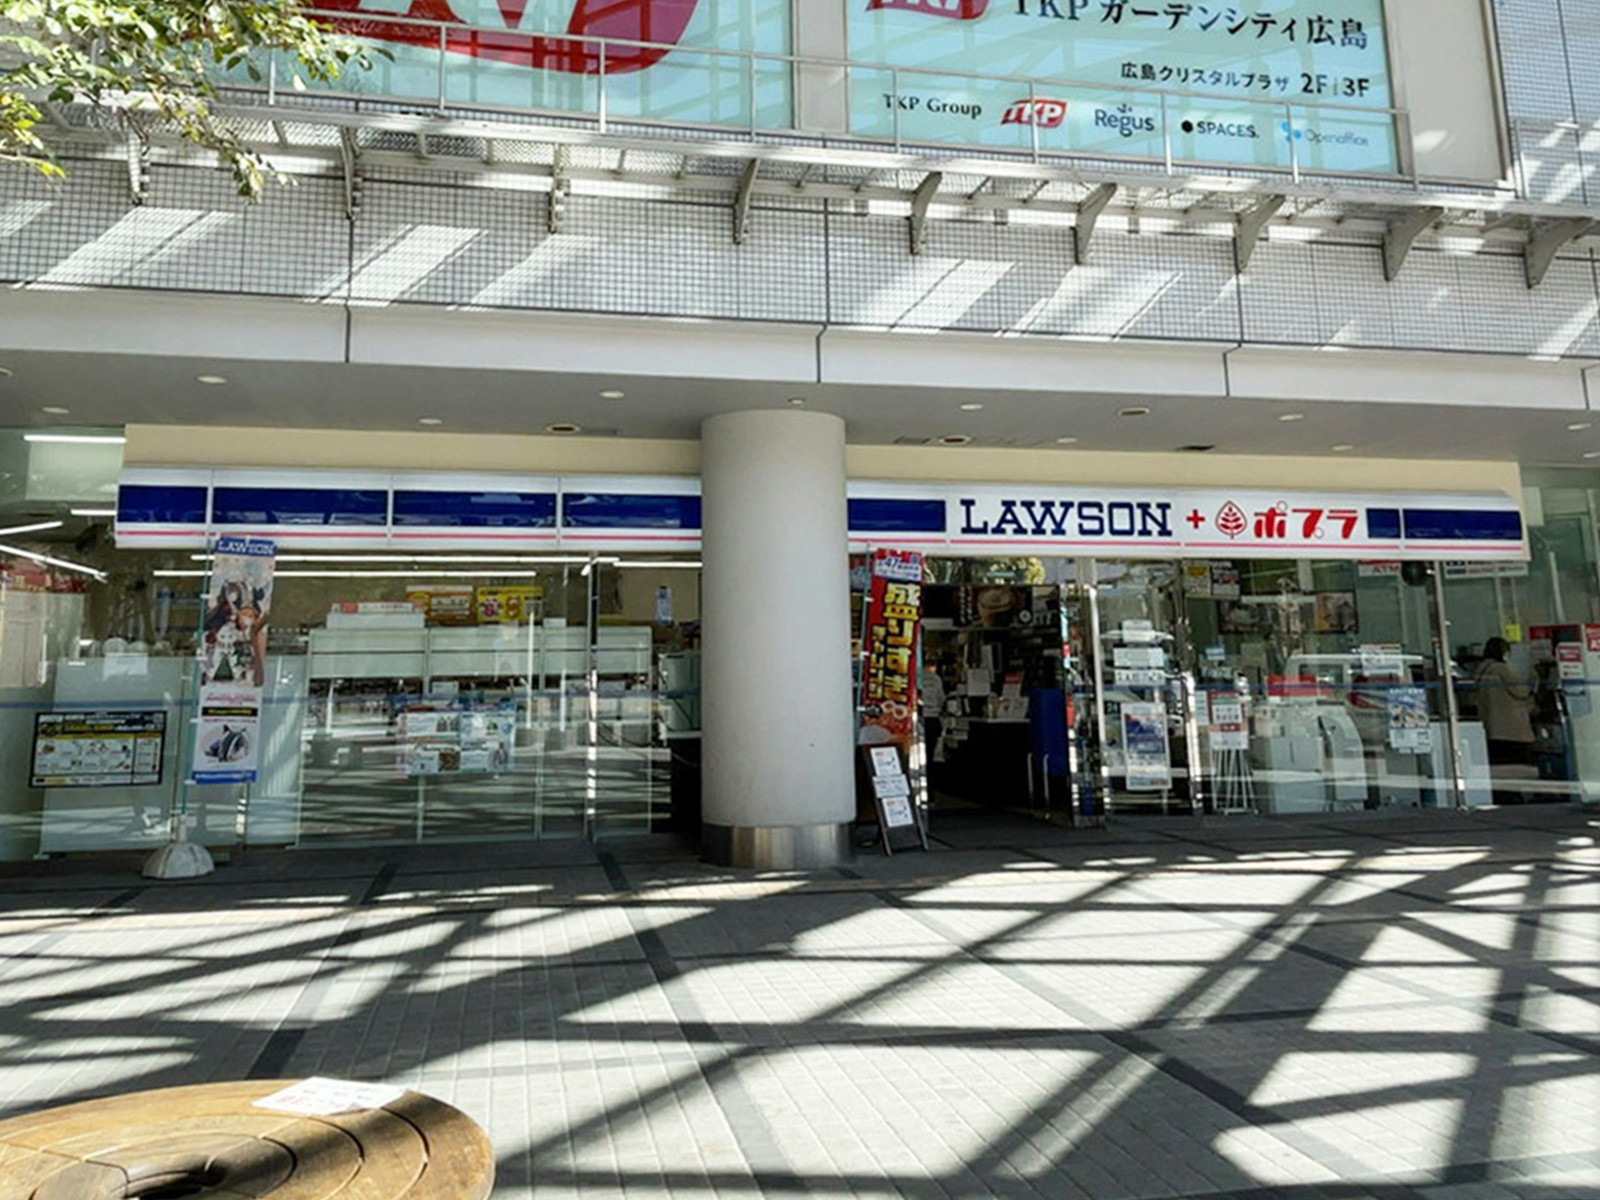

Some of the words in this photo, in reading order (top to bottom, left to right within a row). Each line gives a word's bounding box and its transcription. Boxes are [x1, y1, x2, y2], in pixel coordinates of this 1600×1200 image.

[1100, 0, 1368, 50] ガーデンシティ広島
[1121, 62, 1290, 92] 広島クリスタルプラザ
[882, 93, 920, 110] TKP
[926, 97, 982, 120] Group
[1005, 101, 1064, 126] TKP
[1094, 108, 1155, 137] Regus
[960, 499, 1173, 537] LAWSON
[1254, 500, 1359, 539] ポプラ
